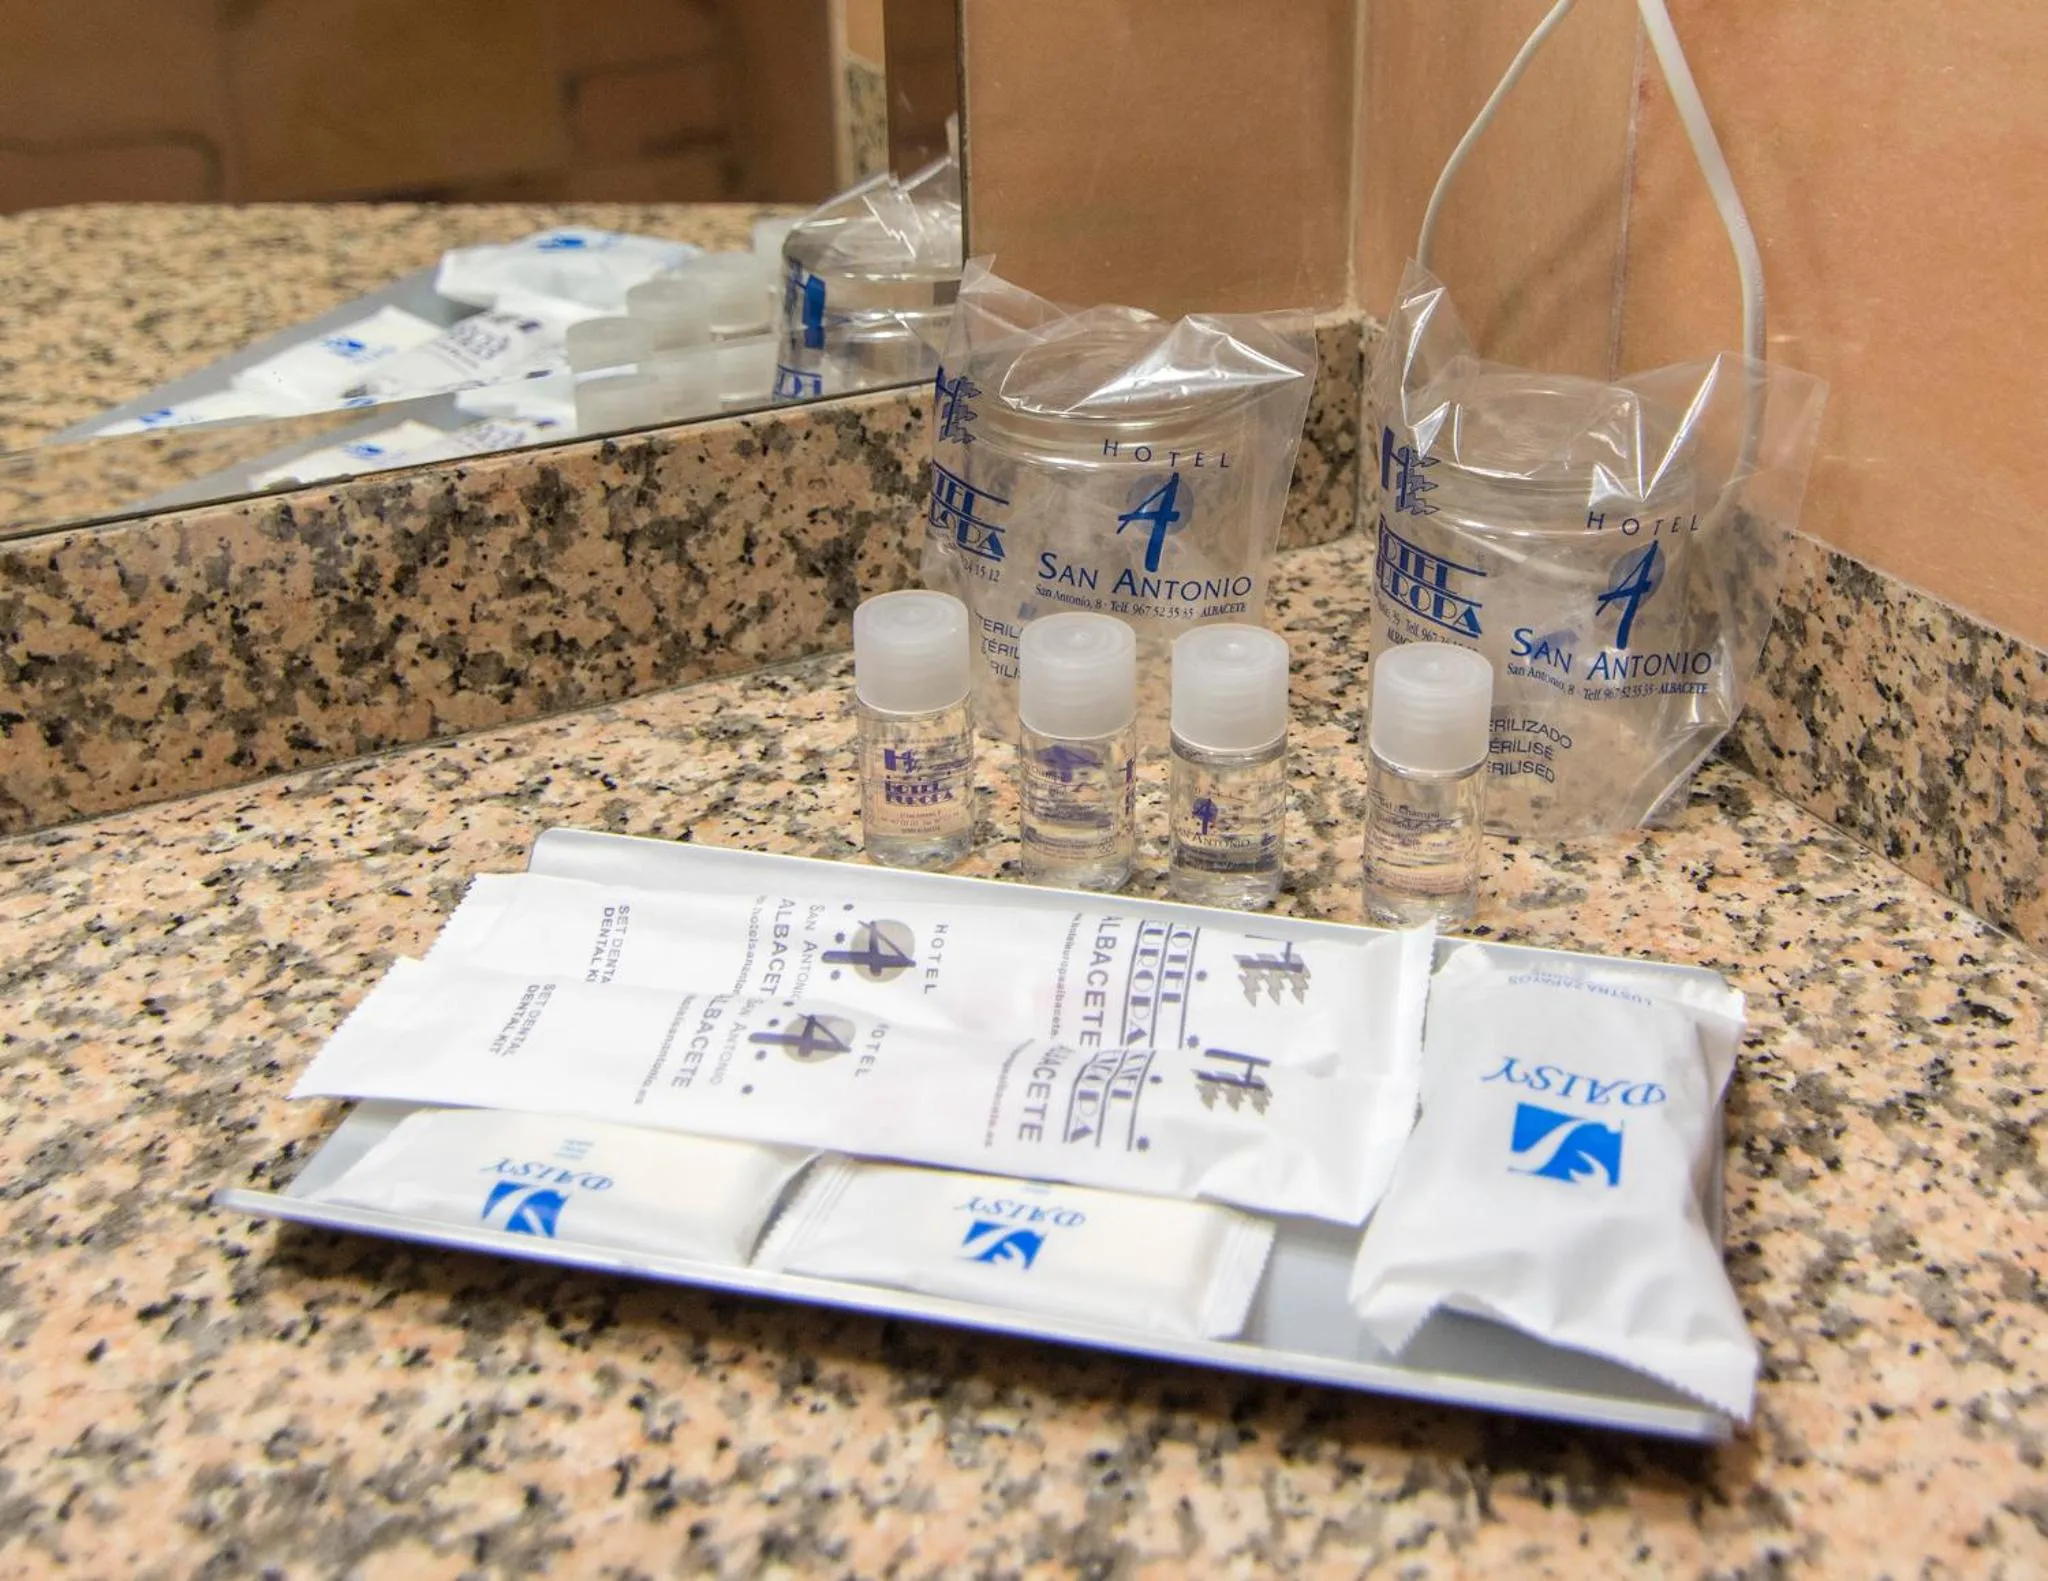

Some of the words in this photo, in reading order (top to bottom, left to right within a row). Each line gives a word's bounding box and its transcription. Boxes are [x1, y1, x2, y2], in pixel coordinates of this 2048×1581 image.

[1104, 438, 1231, 469] HOTEL
[1586, 511, 1700, 536] HOTEL
[1037, 551, 1099, 591] SAN
[1111, 567, 1253, 601] ANTONIO
[1131, 602, 1151, 618] 967
[1509, 627, 1573, 673] SAN
[1586, 651, 1713, 681] ANTONIO
[1506, 662, 1526, 677] San
[1659, 682, 1710, 697] ALBACETE
[590, 907, 616, 966] DENTAL
[760, 897, 797, 996] ALBACET
[923, 923, 950, 995] HOTEL
[1480, 1055, 1668, 1107] DAISY
[480, 1156, 615, 1191] DAISY
[952, 1195, 1088, 1227] DAISY
